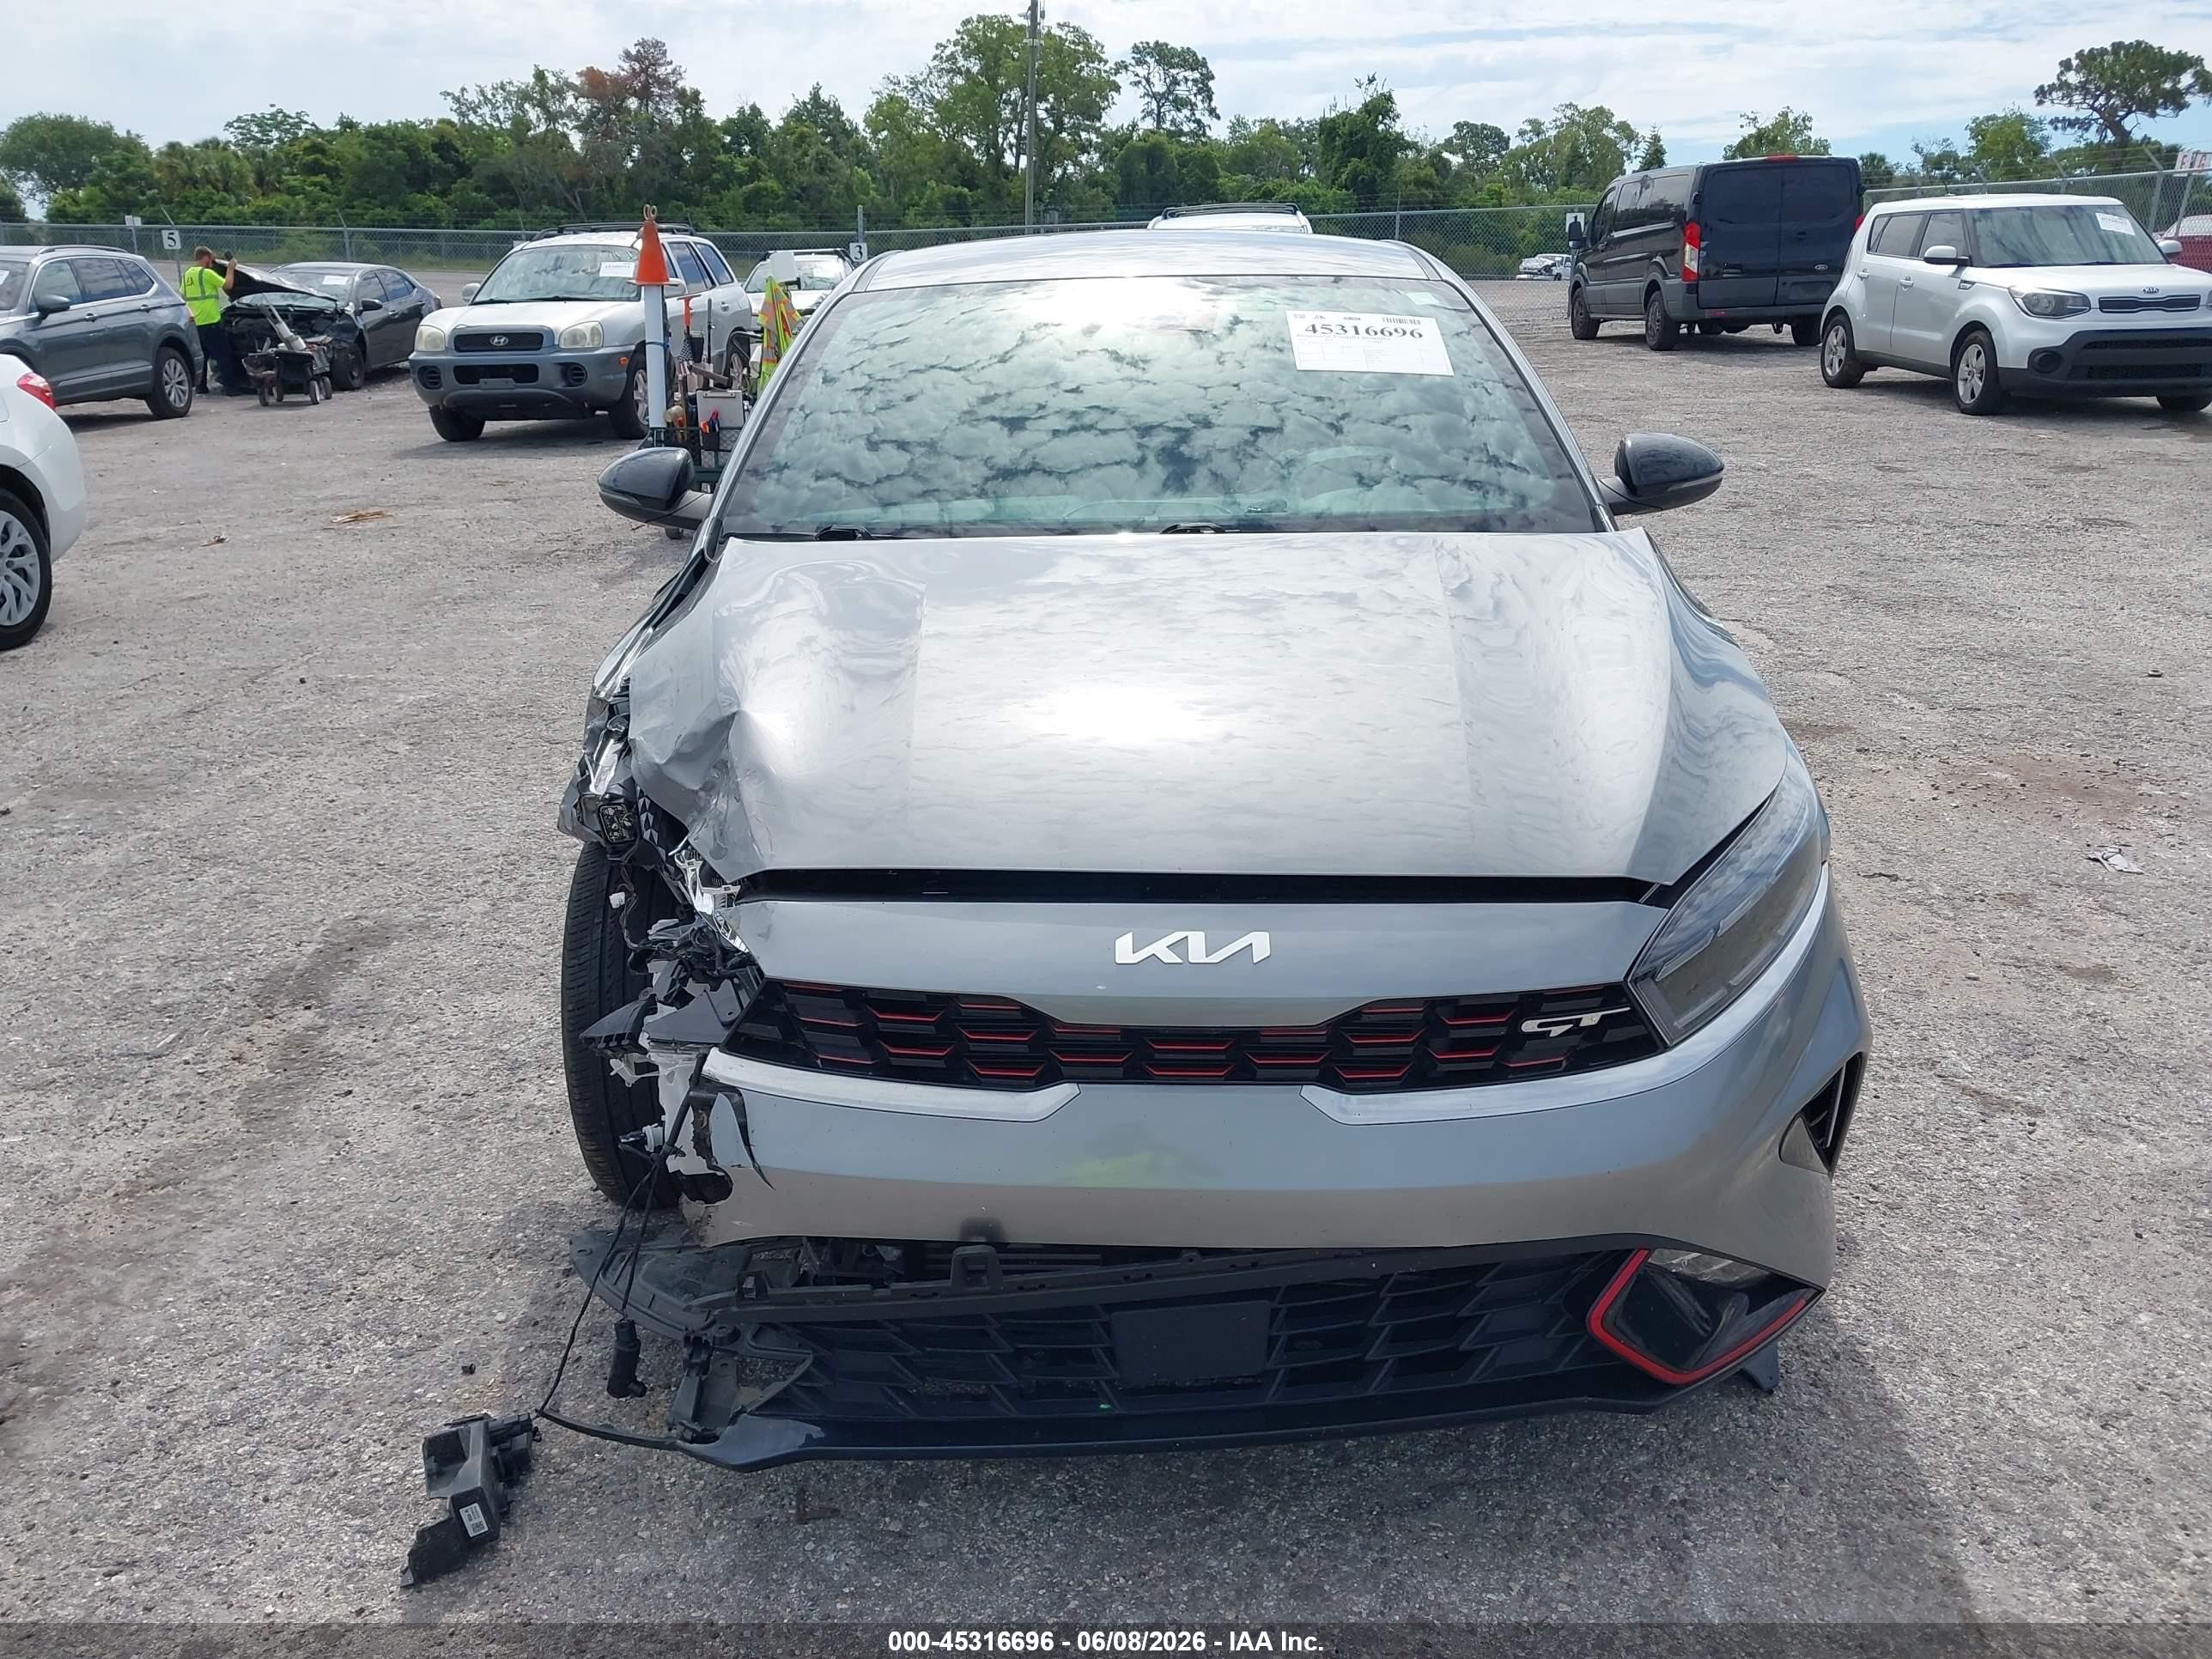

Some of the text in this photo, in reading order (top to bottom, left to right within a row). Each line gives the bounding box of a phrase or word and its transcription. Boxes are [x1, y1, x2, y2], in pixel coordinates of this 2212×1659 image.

[167, 232, 177, 247] 5
[854, 245, 863, 260] 3
[1304, 323, 1424, 339] 45316696
[1115, 931, 1271, 963] KIA
[1521, 1006, 1631, 1037] GT
